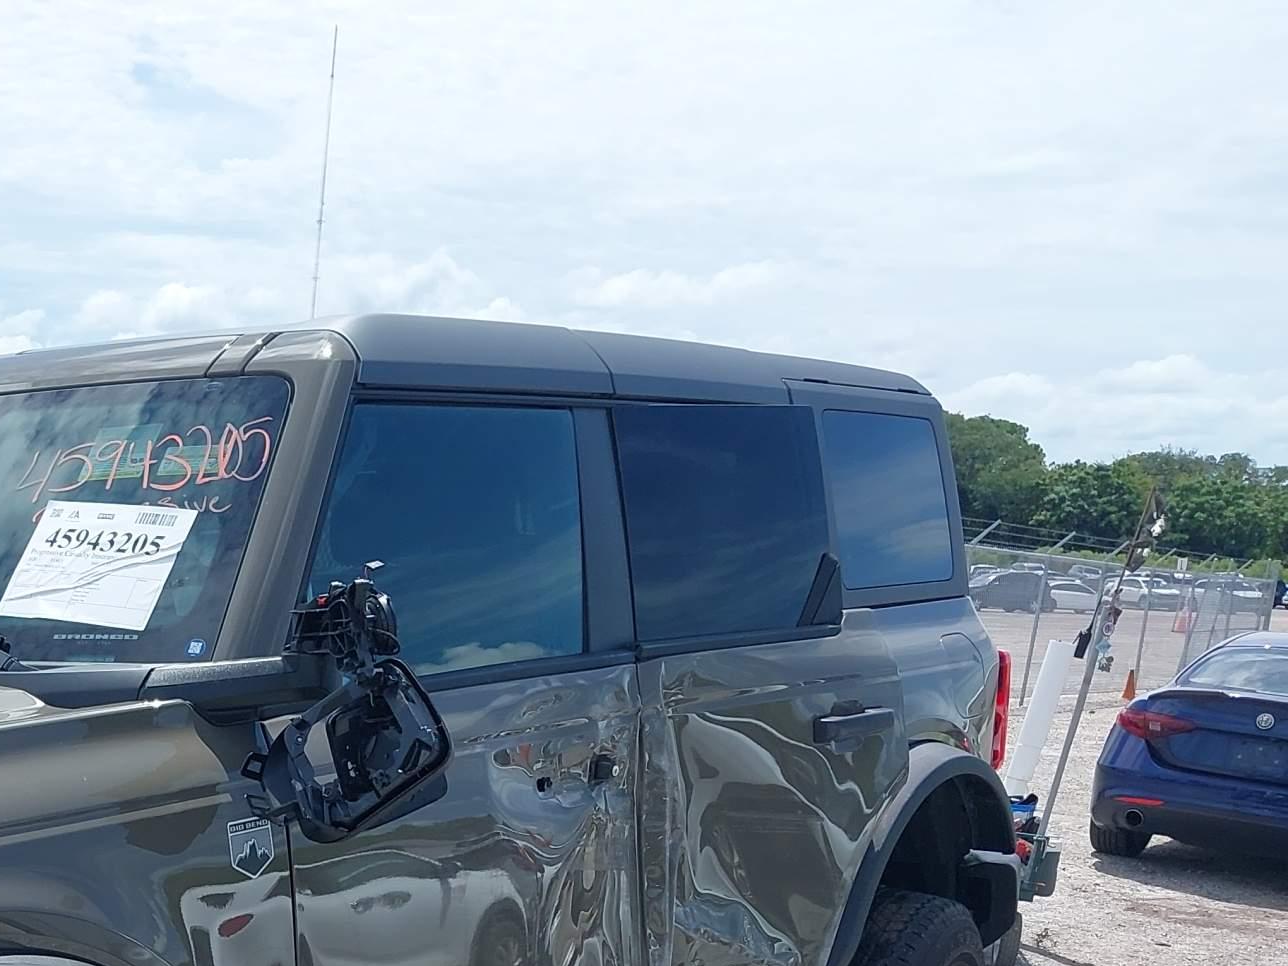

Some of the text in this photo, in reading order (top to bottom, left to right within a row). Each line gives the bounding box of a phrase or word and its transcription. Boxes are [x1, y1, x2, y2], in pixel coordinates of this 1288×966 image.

[16, 416, 273, 503] 45943205
[45, 527, 167, 556] 45943205
[229, 819, 268, 832] BIG BEND
